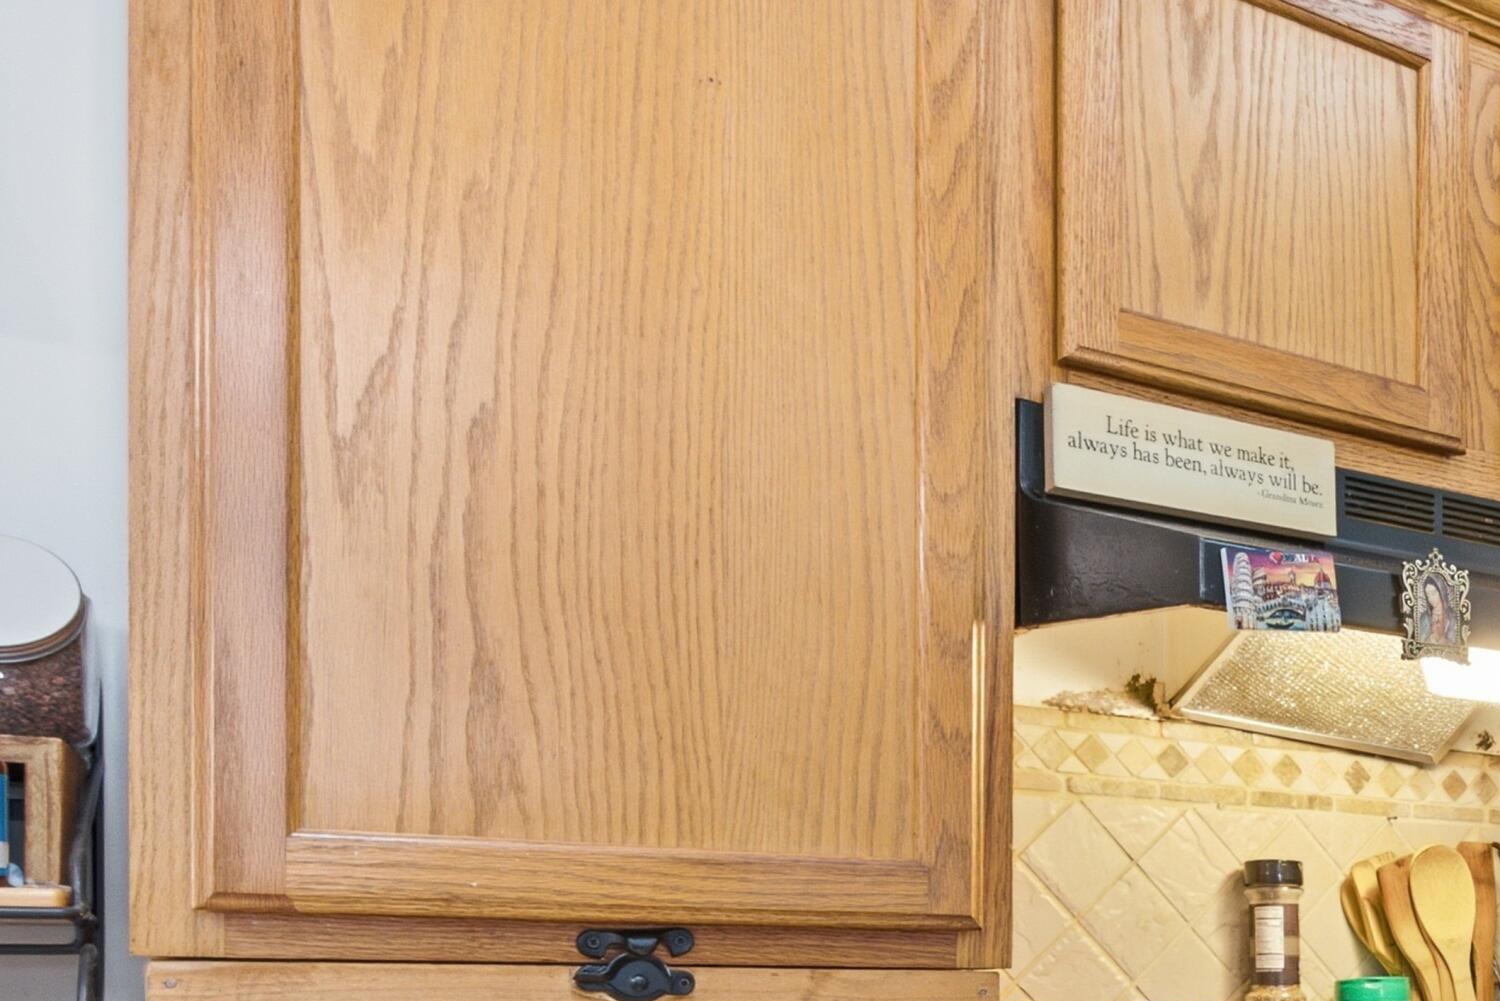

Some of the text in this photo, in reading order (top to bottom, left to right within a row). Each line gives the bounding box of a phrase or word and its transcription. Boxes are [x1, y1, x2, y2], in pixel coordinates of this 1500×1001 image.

[1068, 431, 1323, 496] always has been, always will be.
[1106, 415, 1295, 472] Life is what we make it,
